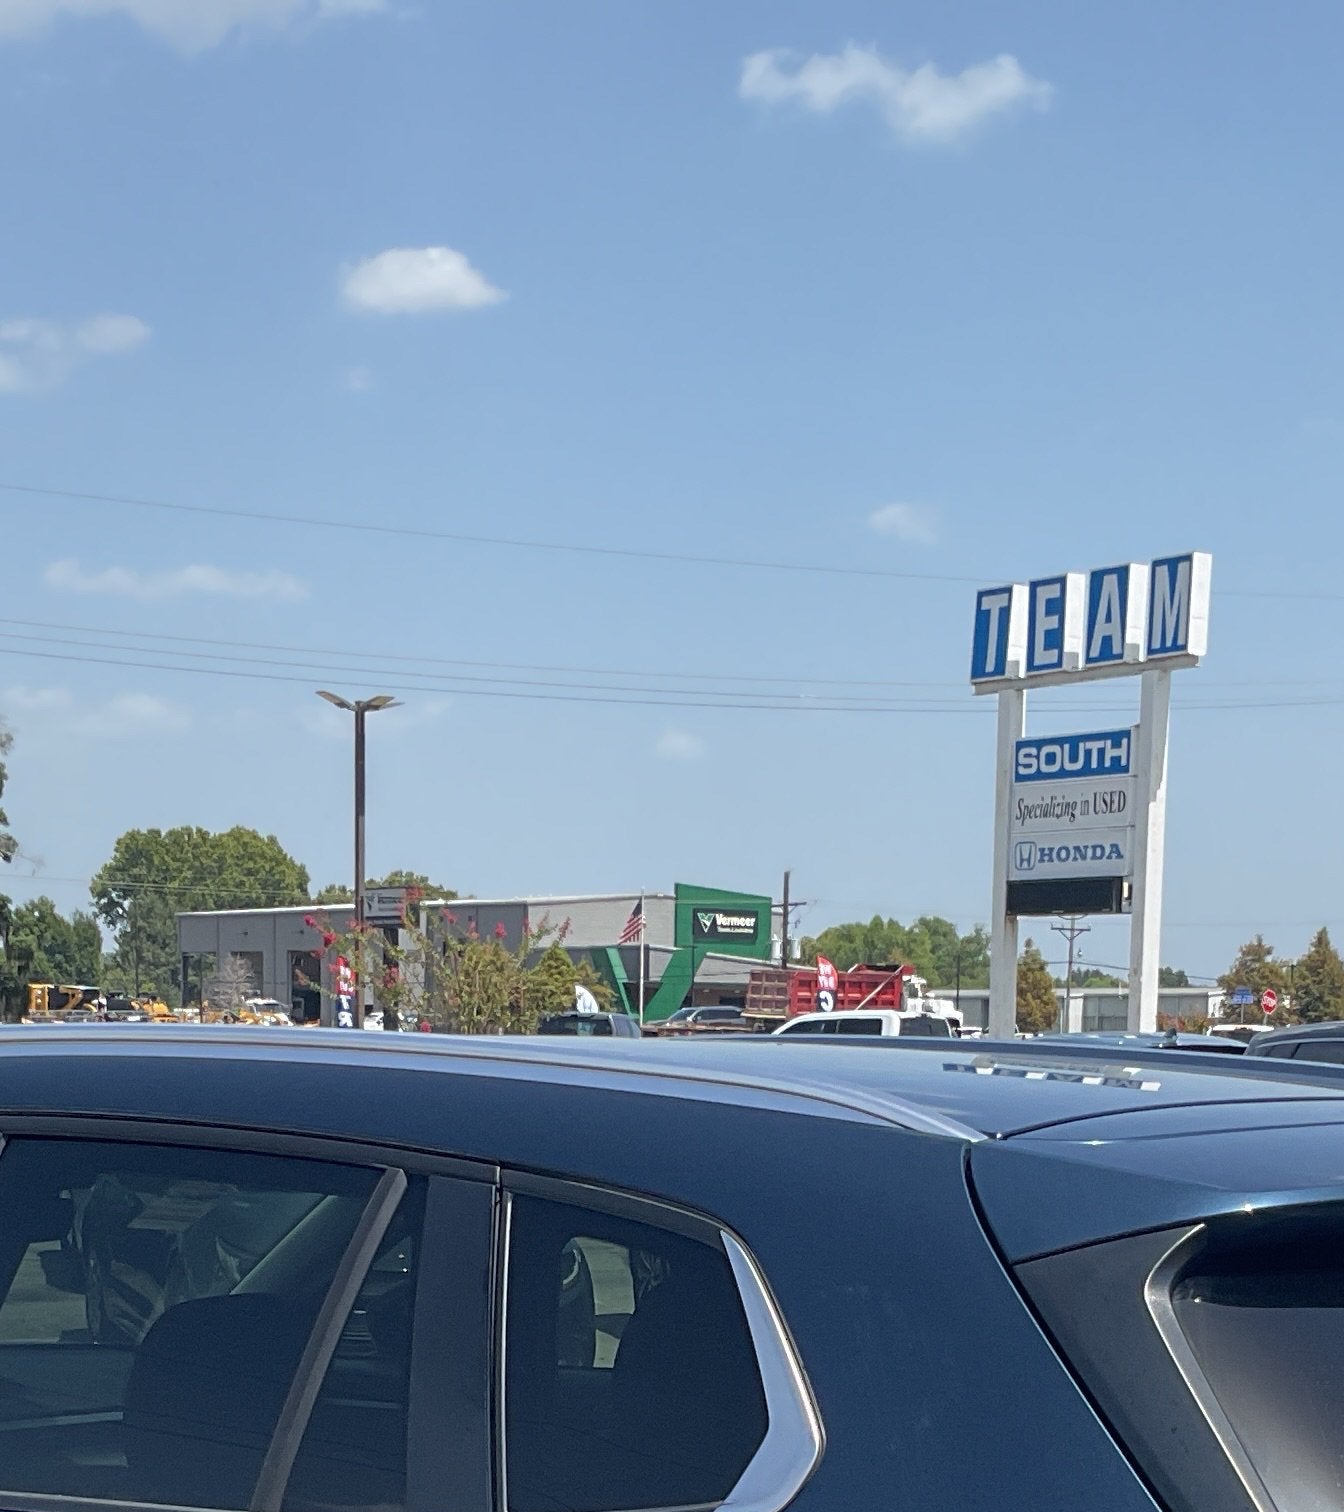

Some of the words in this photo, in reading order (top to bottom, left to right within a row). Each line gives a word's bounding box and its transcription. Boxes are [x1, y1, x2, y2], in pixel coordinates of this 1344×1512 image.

[980, 560, 1190, 673] TEAM
[1016, 737, 1128, 776] SOUTH
[1015, 796, 1078, 824] Specializing
[1080, 799, 1090, 817] in
[1092, 790, 1127, 814] USED
[1038, 842, 1124, 864] HONDA
[715, 913, 756, 927] Vermeer
